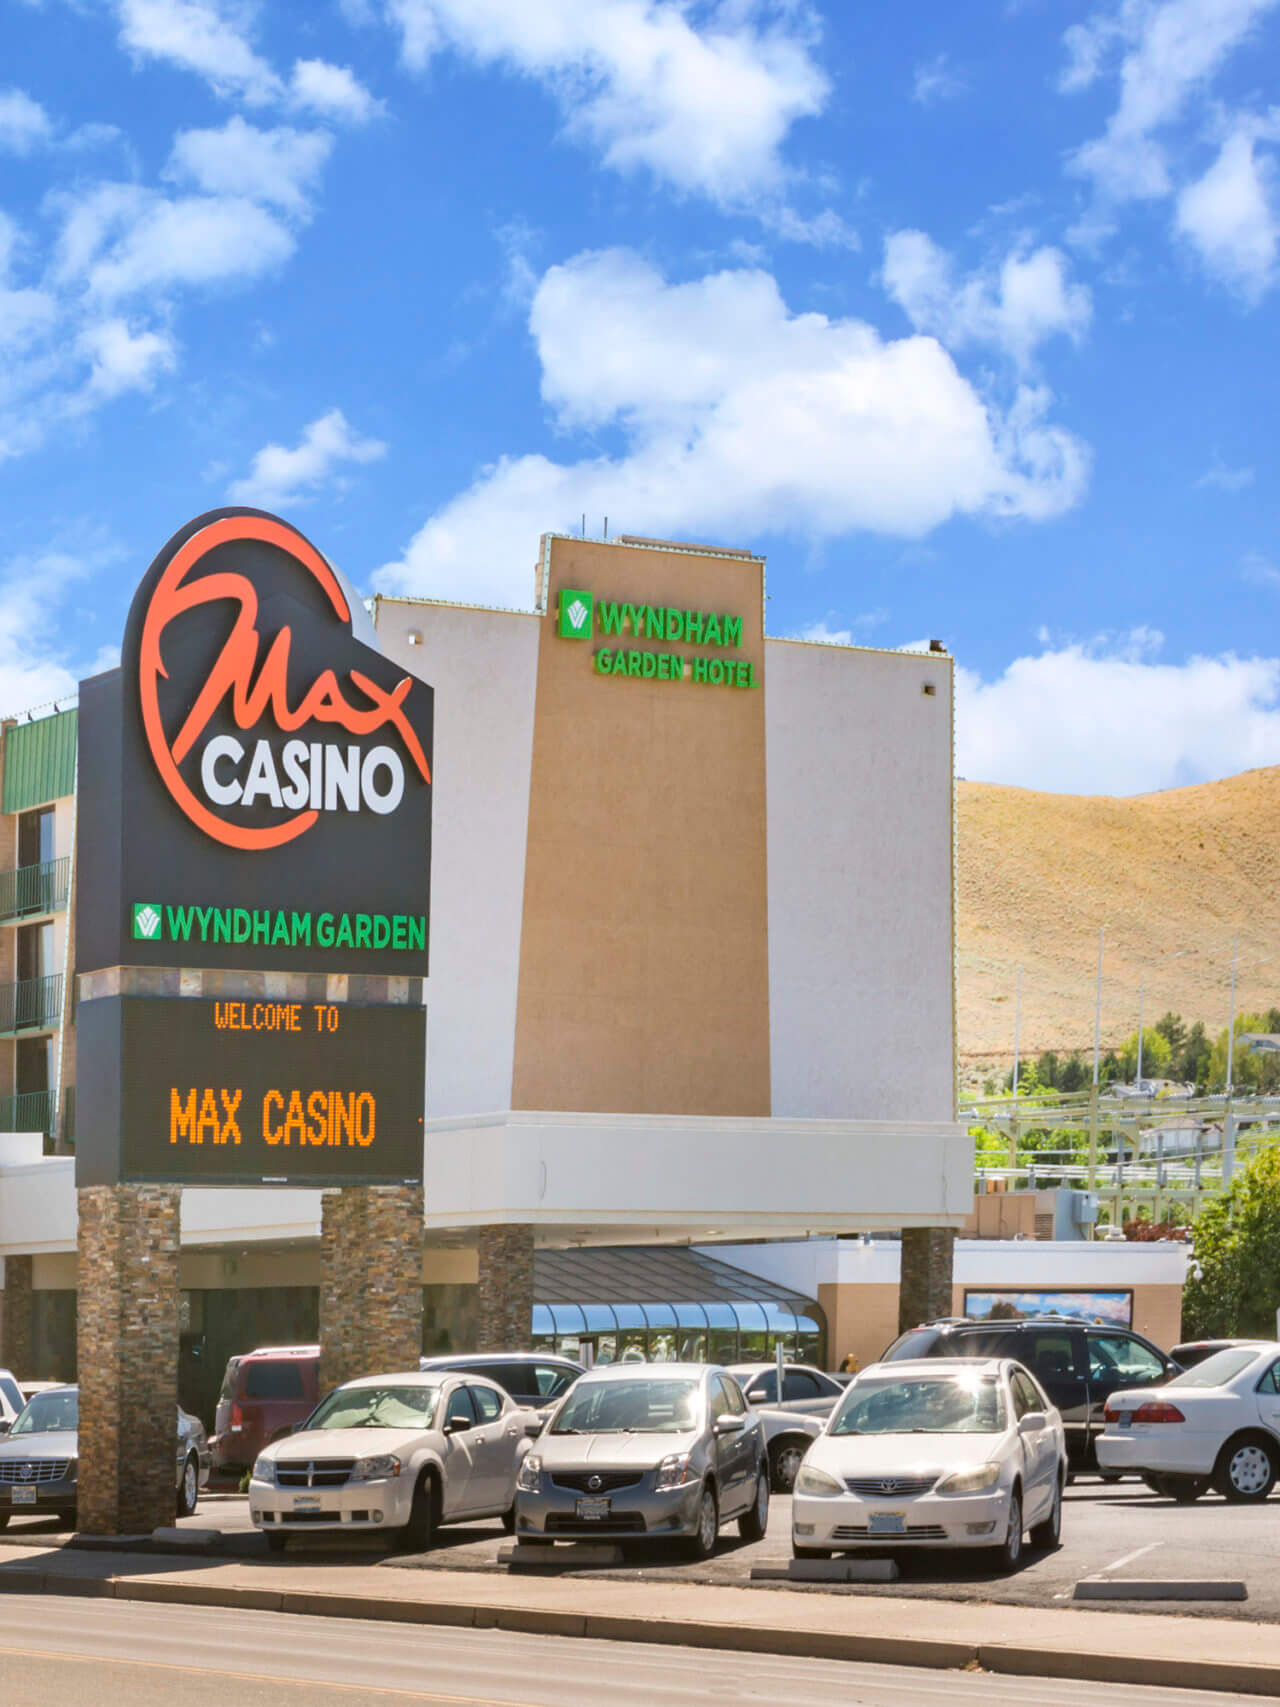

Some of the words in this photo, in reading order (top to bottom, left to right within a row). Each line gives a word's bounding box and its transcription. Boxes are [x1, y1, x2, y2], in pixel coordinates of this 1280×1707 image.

[598, 600, 744, 647] WYNDHAM
[168, 572, 431, 785] Max
[594, 648, 684, 680] GARDEN
[692, 657, 760, 688] HOTEL
[201, 735, 405, 815] CASINO
[166, 905, 311, 946] WYNDHAM
[317, 914, 426, 951] GARDEN
[215, 1002, 302, 1031] WELCOME
[314, 1006, 339, 1032] TO
[170, 1088, 242, 1144] MAX
[262, 1090, 376, 1146] CASINO
